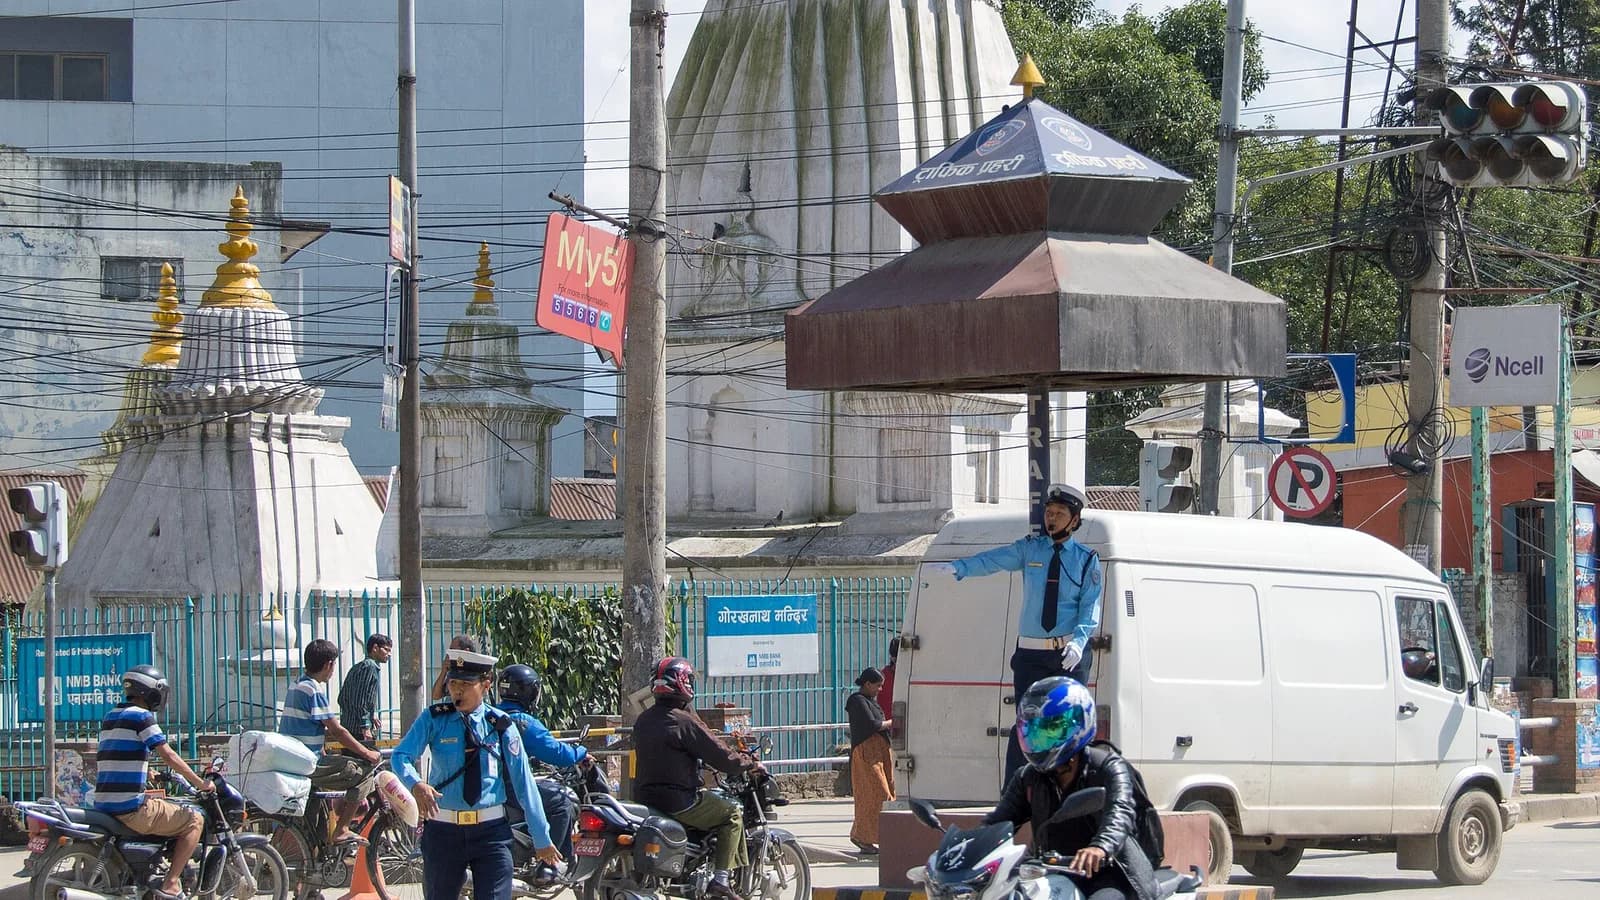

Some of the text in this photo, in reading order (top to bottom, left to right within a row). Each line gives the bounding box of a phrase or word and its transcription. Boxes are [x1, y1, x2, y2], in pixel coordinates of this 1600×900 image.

[557, 230, 618, 288] My5
[1495, 355, 1544, 376] Ncell
[1288, 461, 1323, 503] P
[718, 605, 809, 624] गोरखनाथ मन्दिर
[66, 674, 121, 688] NMB BANK
